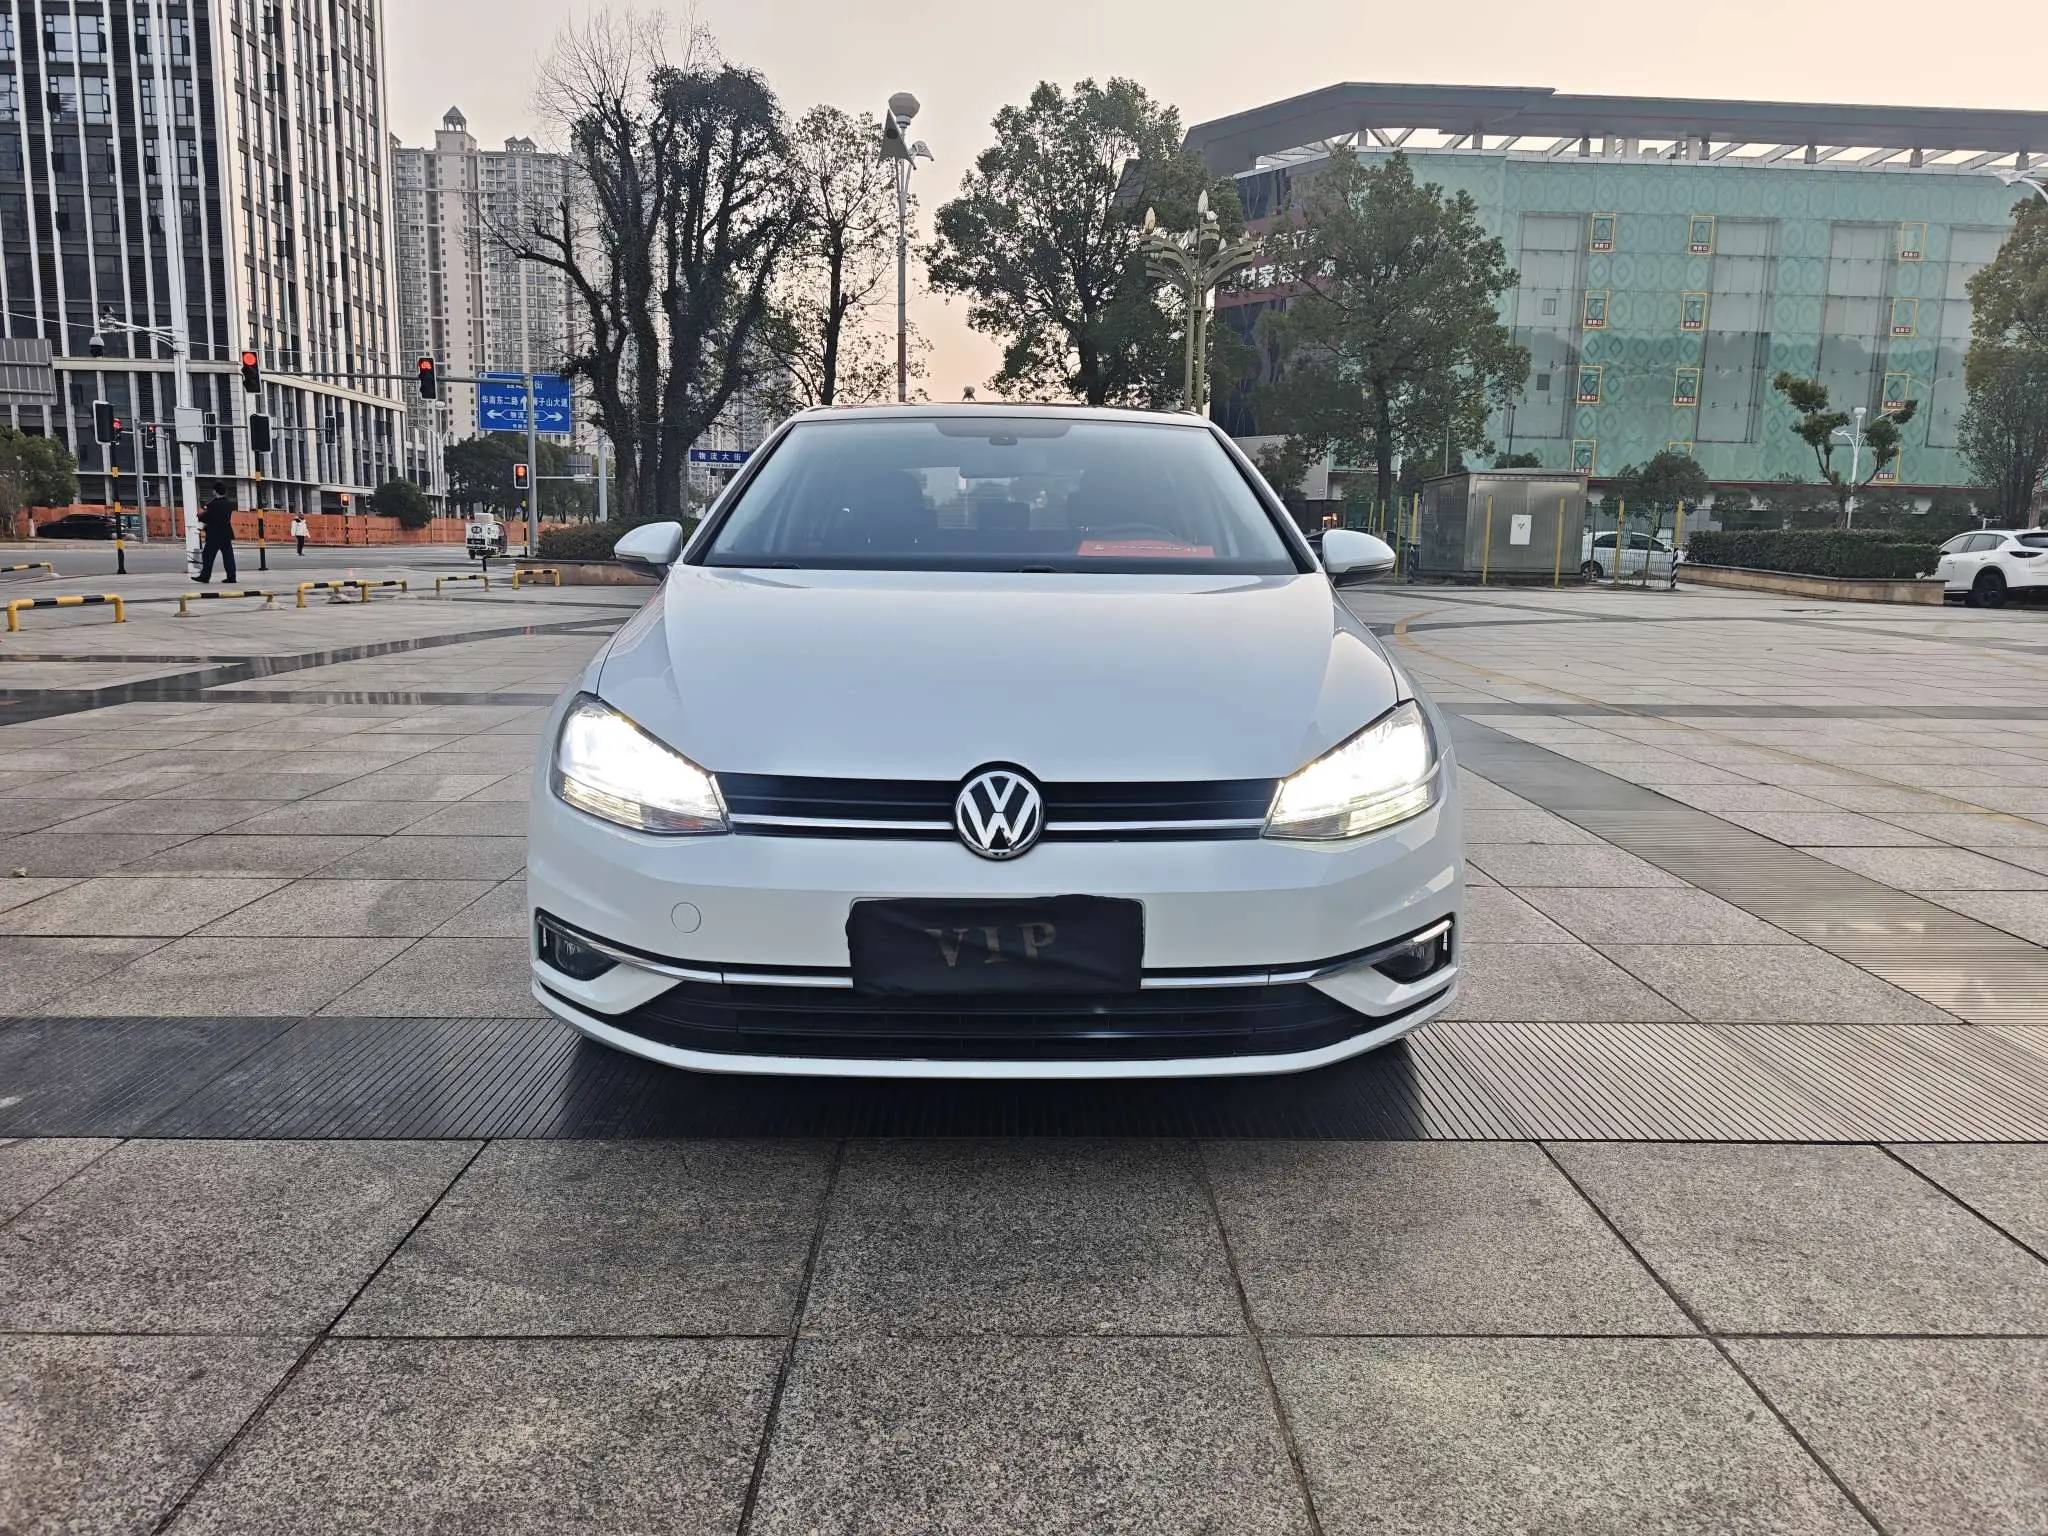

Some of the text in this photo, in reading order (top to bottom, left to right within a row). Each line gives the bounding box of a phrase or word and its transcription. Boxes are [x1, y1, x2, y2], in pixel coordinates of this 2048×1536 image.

[698, 451, 742, 461] 物流大街
[924, 921, 1057, 967] VIP
